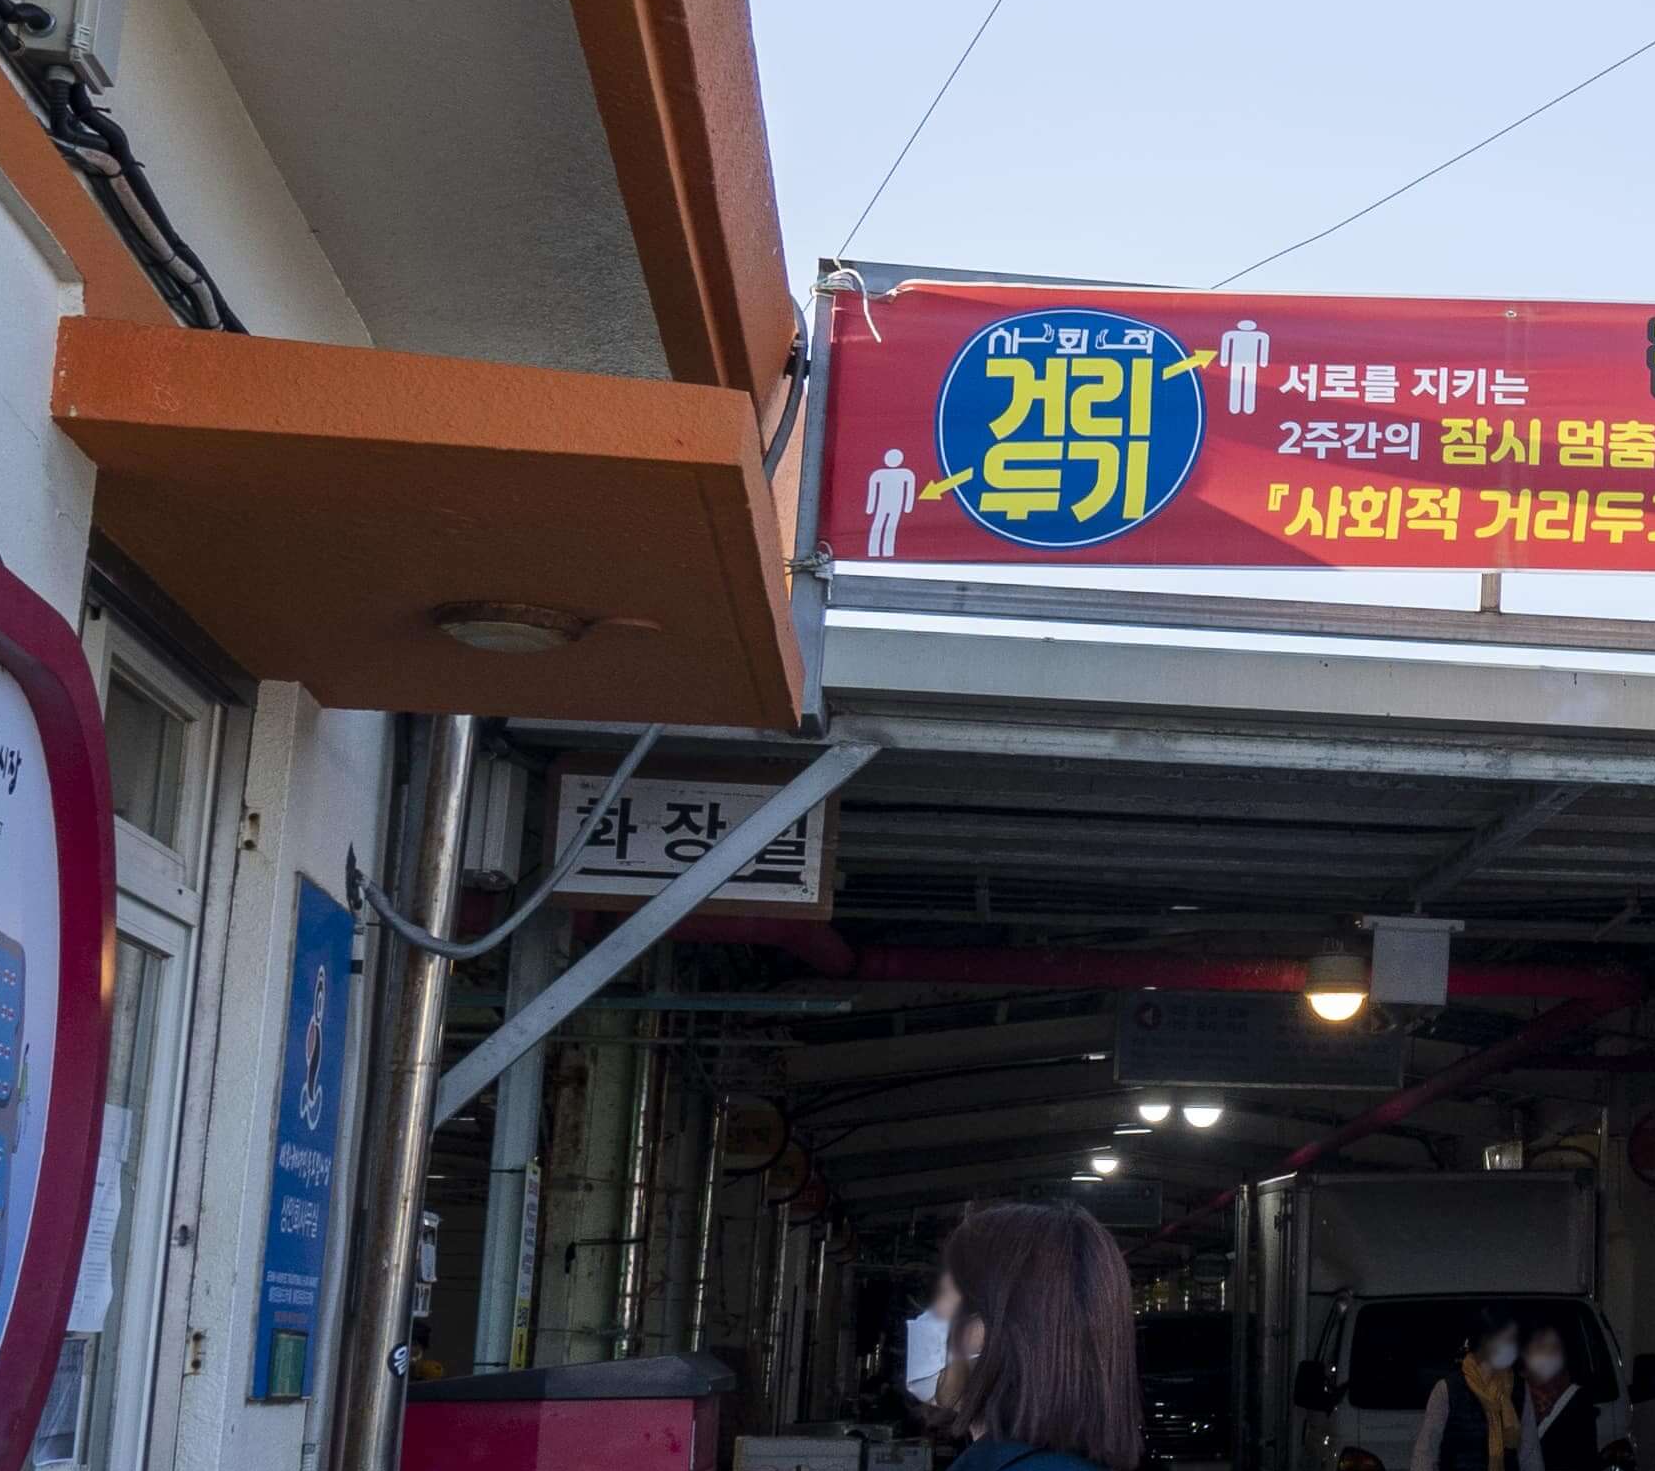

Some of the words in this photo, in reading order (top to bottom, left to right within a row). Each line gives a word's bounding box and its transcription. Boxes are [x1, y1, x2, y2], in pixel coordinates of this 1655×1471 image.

[985, 357, 1154, 441] 거리
[1278, 362, 1402, 401] 서로를
[1410, 365, 1529, 407] 지키는
[1278, 418, 1420, 462] 2주간의
[1439, 416, 1542, 467] 잠시
[979, 440, 1150, 523] 두기
